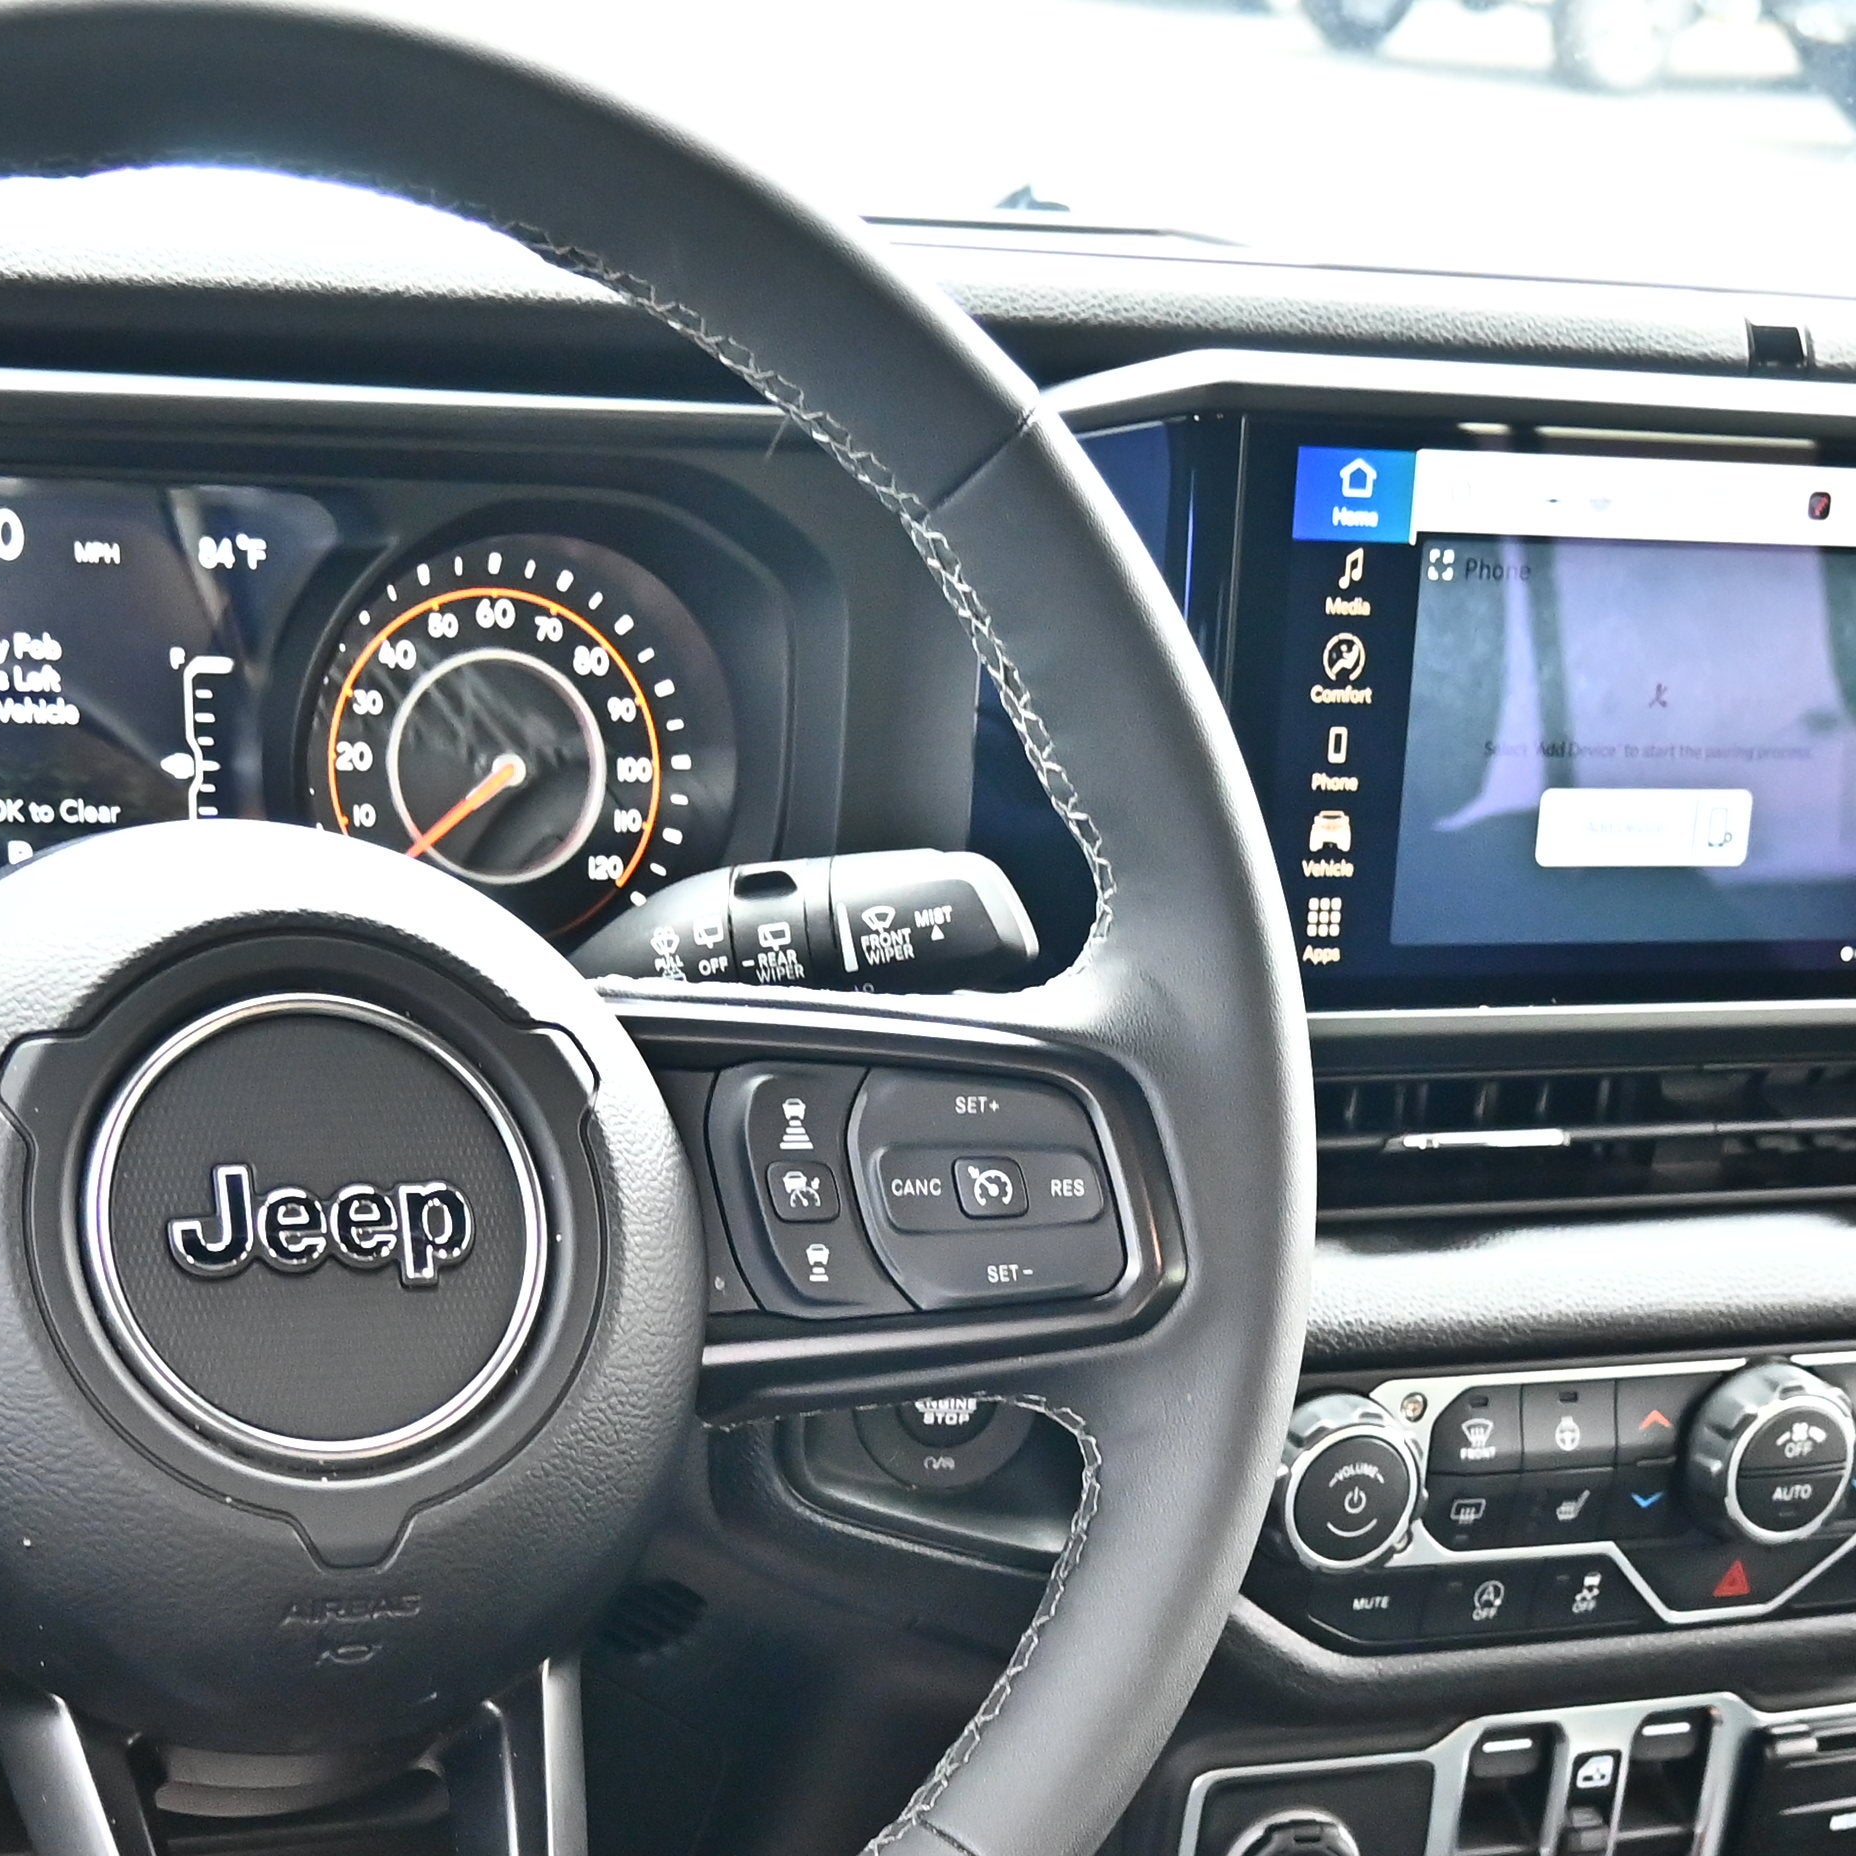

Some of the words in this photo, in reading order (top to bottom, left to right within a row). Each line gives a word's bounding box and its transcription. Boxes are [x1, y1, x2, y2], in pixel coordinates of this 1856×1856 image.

[1331, 506, 1379, 529] Home
[74, 540, 121, 564] MPH
[1463, 557, 1532, 583] Phone
[475, 598, 516, 629] 60
[1325, 596, 1371, 616] Media
[428, 612, 459, 638] 50
[534, 616, 564, 642] 70
[13, 632, 63, 661] Fob
[378, 639, 417, 670] 40
[572, 645, 610, 677] 80
[13, 664, 62, 693] Left
[352, 689, 384, 715] 30
[1310, 685, 1373, 706] Comfort
[607, 696, 637, 723] 90
[335, 741, 373, 772] 20
[617, 757, 653, 783] 100
[1311, 772, 1359, 793] Phone
[28, 802, 55, 824] to
[59, 798, 122, 824] Clear
[352, 803, 376, 828] 10
[614, 808, 643, 833] 110
[588, 855, 624, 880] 120
[1302, 859, 1354, 879] Vehicle
[914, 905, 953, 929] MIST
[860, 927, 912, 951] FRONT
[698, 956, 729, 977] OFF
[757, 949, 798, 970] REAR
[865, 944, 915, 967] WIPER
[1302, 944, 1341, 966] Apps
[756, 964, 805, 986] WIPER
[955, 1096, 1000, 1115] SET+
[891, 1178, 942, 1197] CANC
[1050, 1178, 1085, 1197] RES
[168, 1164, 475, 1288] Jeep
[924, 1411, 970, 1426] STOP
[1784, 1442, 1813, 1458] OFF
[1336, 1462, 1379, 1482] VOLUME
[1772, 1484, 1812, 1502] AUTO
[279, 1594, 423, 1627] AIRBAG
[1352, 1595, 1390, 1611] MUTE
[1472, 1608, 1498, 1622] OFF
[1571, 1600, 1597, 1614] OFF
